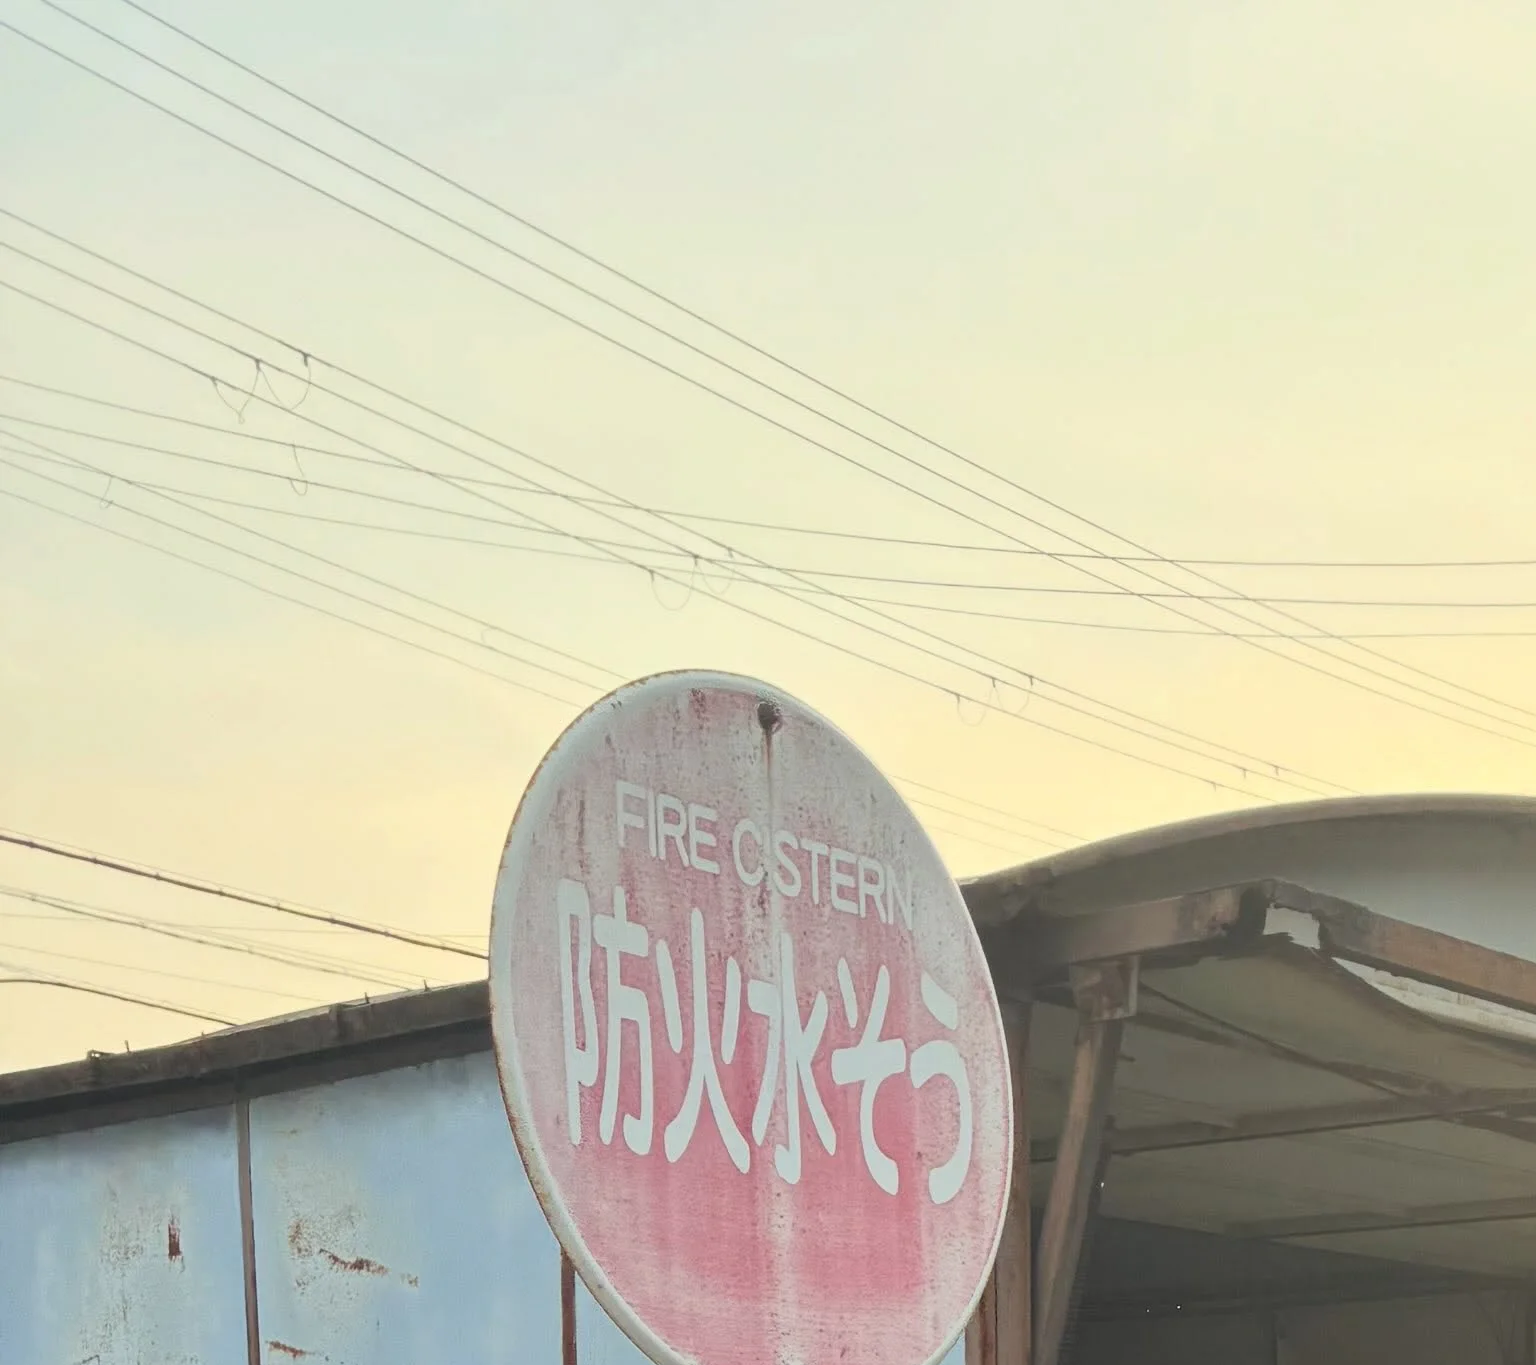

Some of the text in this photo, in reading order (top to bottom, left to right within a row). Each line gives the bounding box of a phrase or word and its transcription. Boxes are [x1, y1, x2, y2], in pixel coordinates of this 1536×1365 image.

[616, 779, 720, 875] FIRE
[559, 880, 973, 1205] 防火水そう
